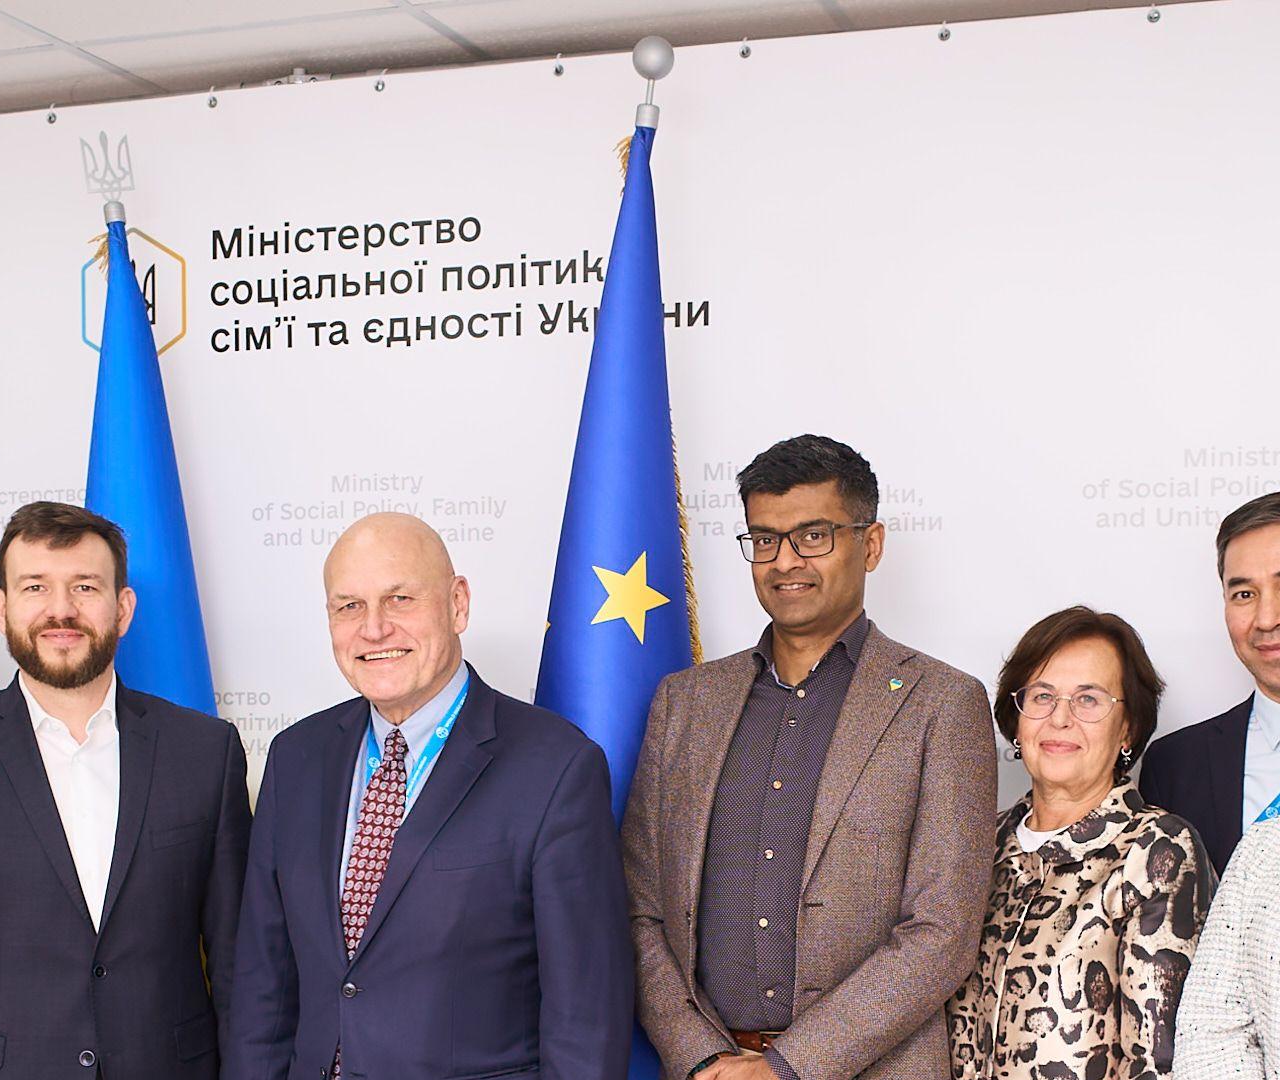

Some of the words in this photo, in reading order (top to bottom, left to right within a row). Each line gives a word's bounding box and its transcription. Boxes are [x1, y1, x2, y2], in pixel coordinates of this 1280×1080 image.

[211, 216, 482, 260] Міністерство
[210, 260, 428, 307] соціальної
[441, 250, 605, 292] політик
[307, 319, 349, 347] та
[362, 302, 522, 348] єдності
[537, 300, 710, 335] Укни
[330, 472, 424, 495] Ministry
[1081, 477, 1110, 500] of
[1118, 476, 1199, 500] Social
[251, 501, 275, 521] of
[280, 499, 345, 521] Social
[431, 496, 507, 519] Family
[1095, 507, 1145, 529] and
[262, 527, 303, 547] and
[441, 523, 495, 543] raine
[698, 520, 725, 537] та
[880, 512, 943, 532] аїни
